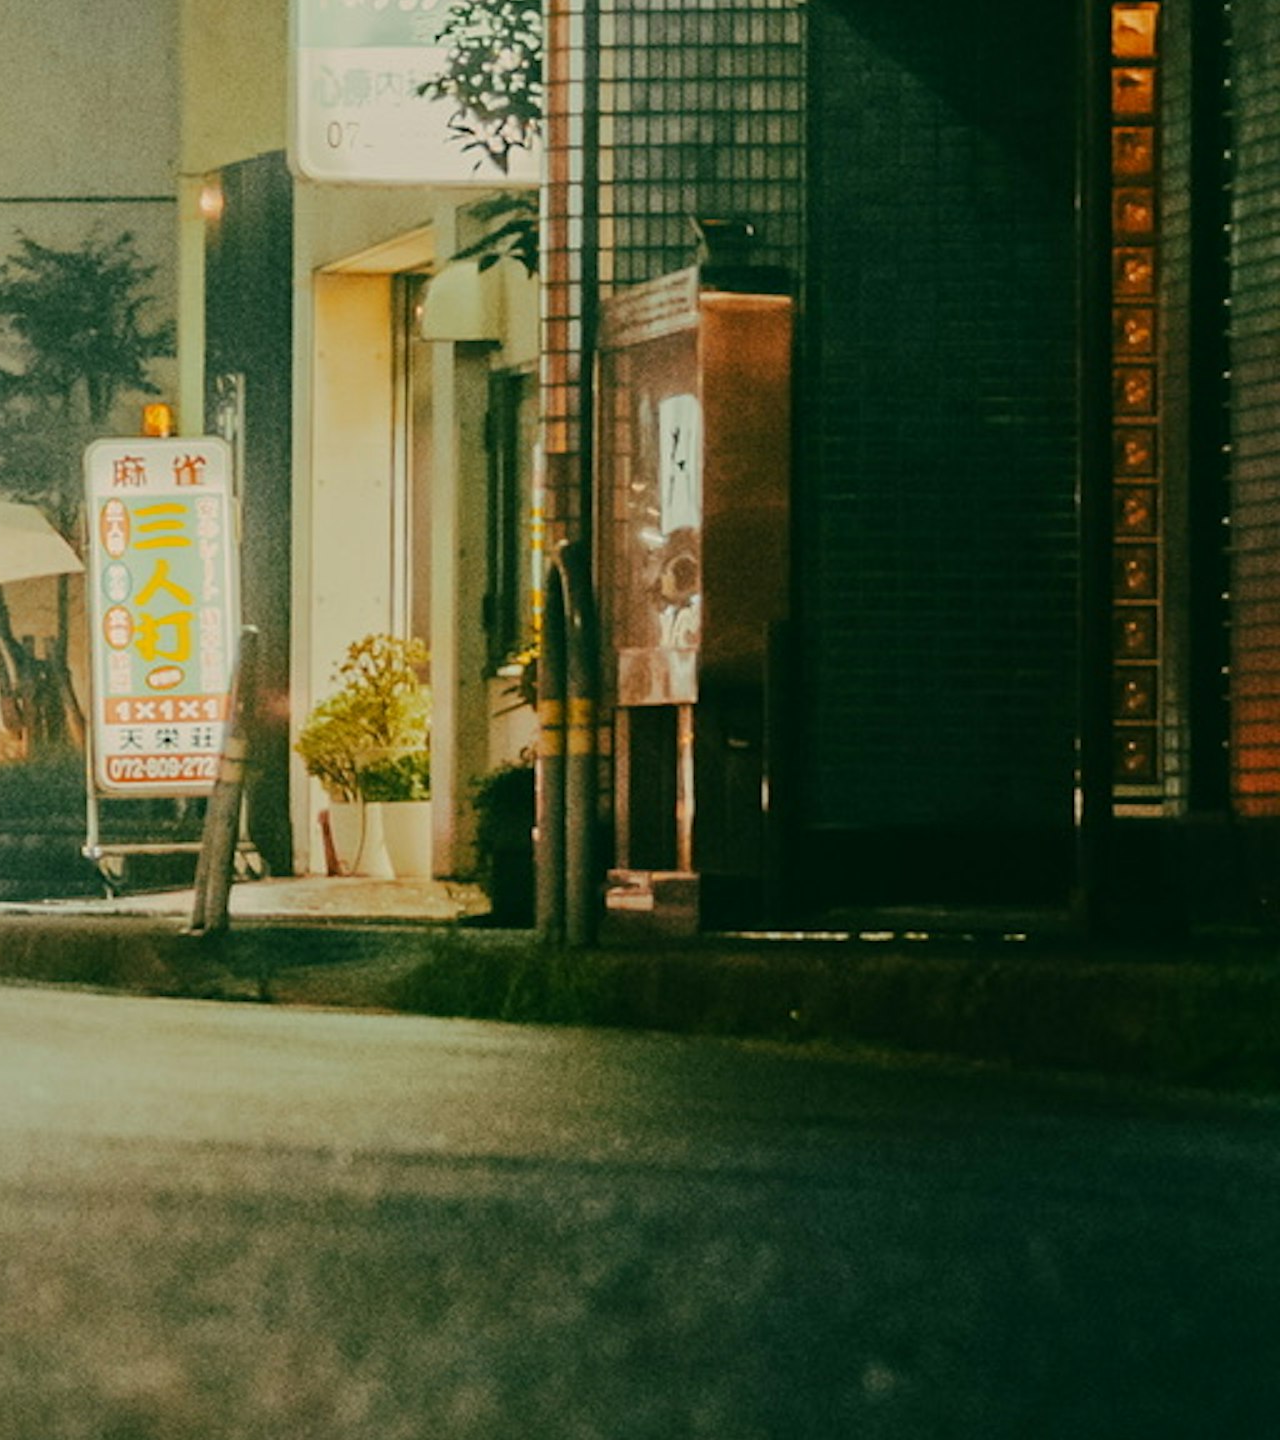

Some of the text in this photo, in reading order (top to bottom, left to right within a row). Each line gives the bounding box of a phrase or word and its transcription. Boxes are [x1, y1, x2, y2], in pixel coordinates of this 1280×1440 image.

[111, 454, 208, 488] 麻雀
[132, 501, 196, 663] 三人打
